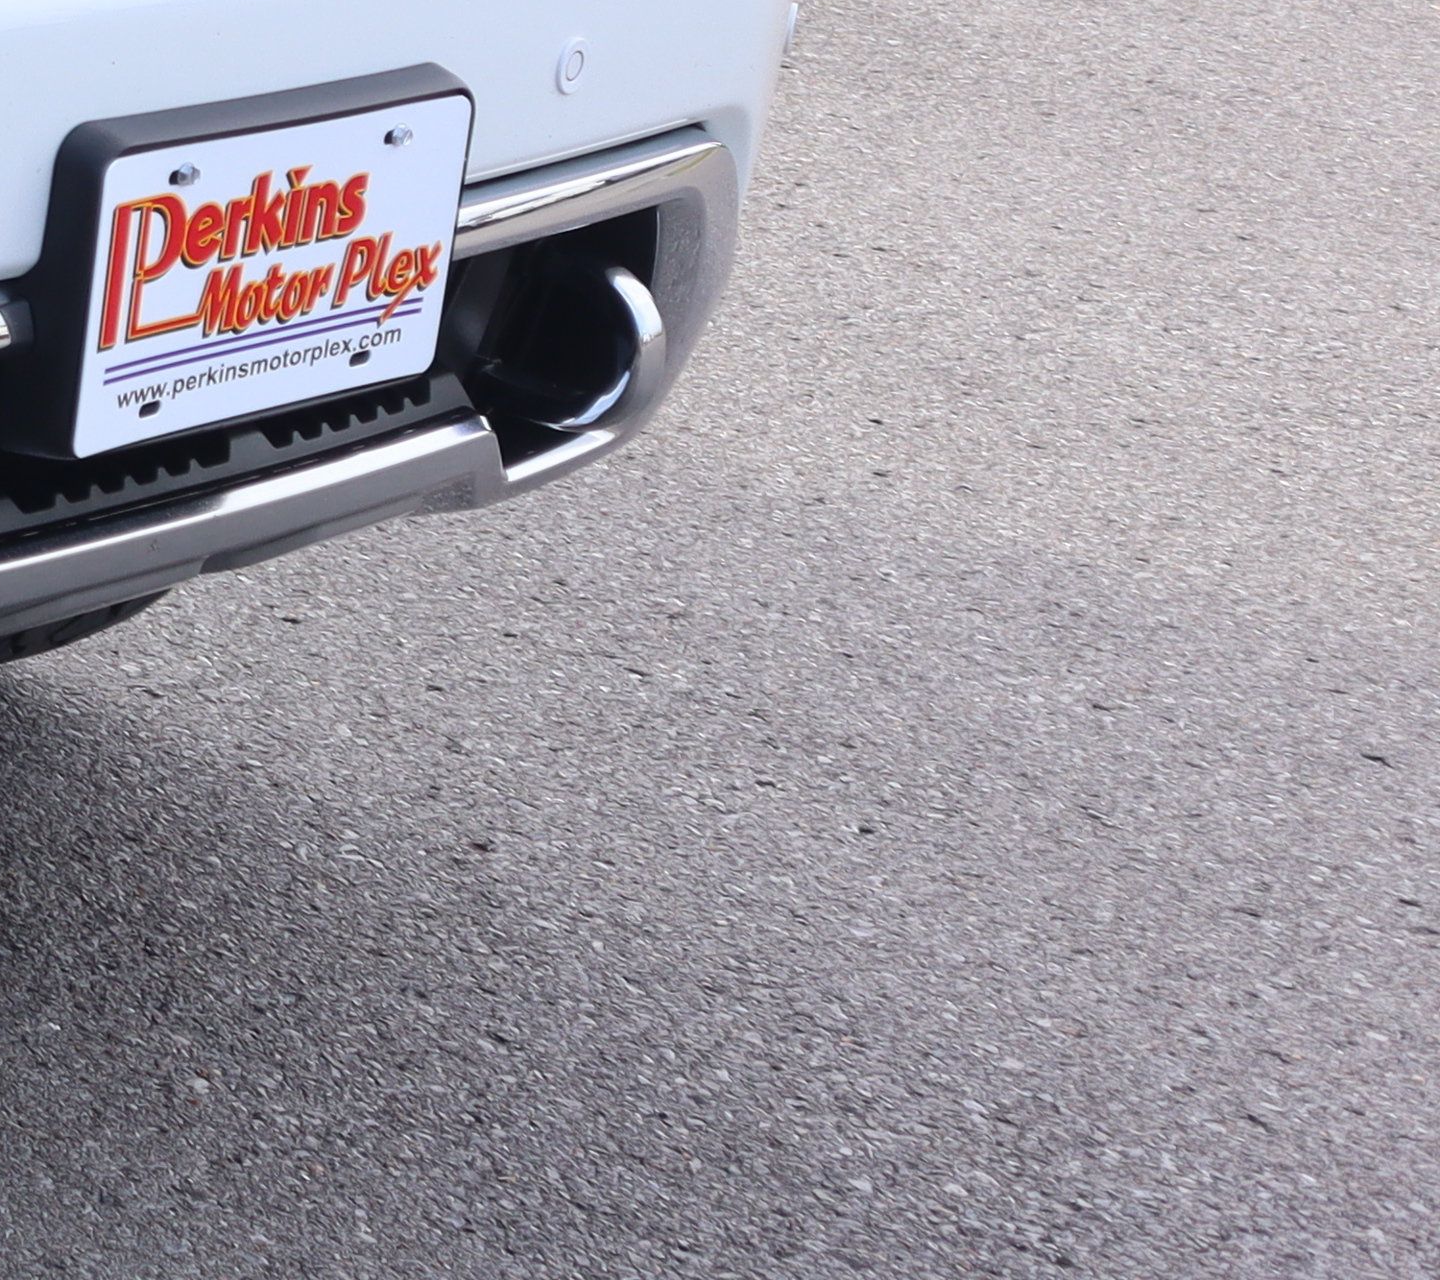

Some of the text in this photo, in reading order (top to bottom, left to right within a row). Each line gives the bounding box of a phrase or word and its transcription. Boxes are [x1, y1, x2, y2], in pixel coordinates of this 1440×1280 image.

[97, 165, 370, 353] Perkins
[196, 231, 443, 338] Motor Plex
[116, 327, 402, 408] www.perkinsmotorplex.com
